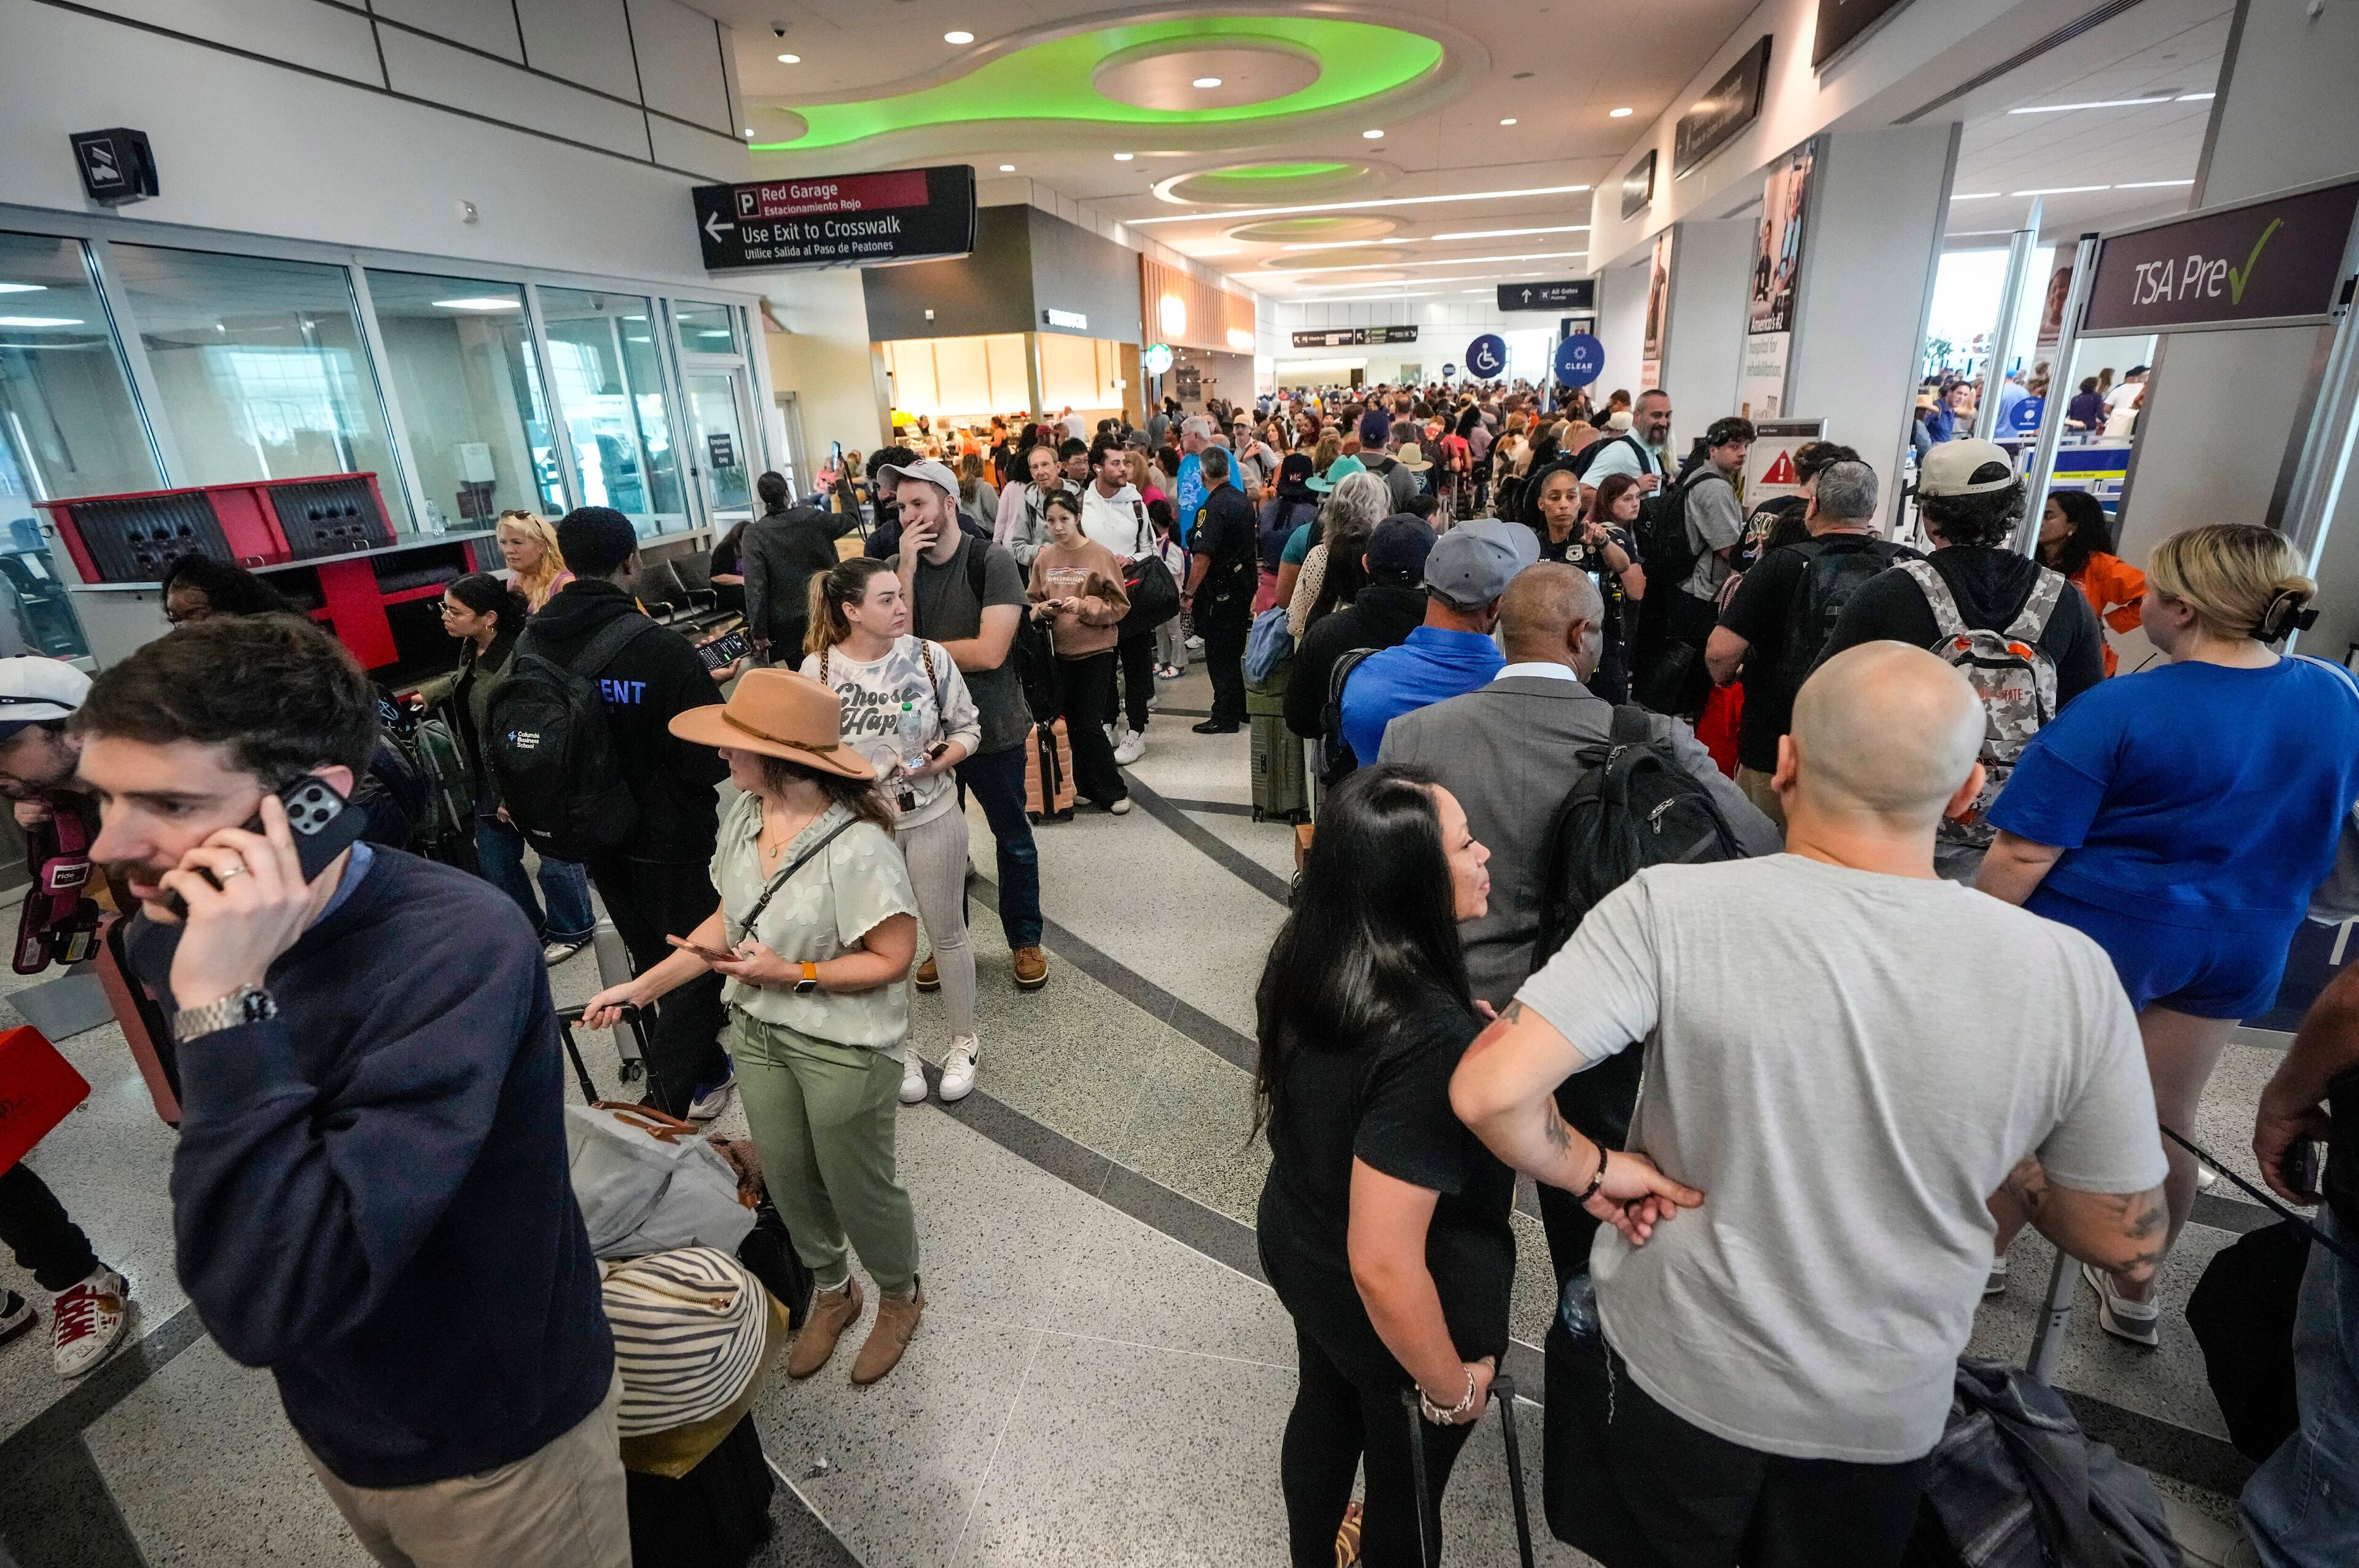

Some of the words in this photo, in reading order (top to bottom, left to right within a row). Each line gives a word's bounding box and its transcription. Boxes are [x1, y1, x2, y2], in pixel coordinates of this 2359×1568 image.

[762, 186, 786, 201] Red
[790, 183, 838, 198] Garage
[741, 193, 754, 213] P
[764, 202, 838, 216] Estacionamiento
[840, 199, 861, 211] Rojo
[742, 225, 769, 243] Use
[774, 224, 800, 241] Exit
[804, 222, 820, 238] to
[824, 216, 901, 238] Crosswalk
[745, 247, 772, 260] Utilice
[775, 244, 800, 257] Salida
[804, 245, 812, 255] al
[814, 244, 835, 254] Paso
[838, 242, 850, 252] de
[852, 240, 894, 253] Peatones
[2133, 259, 2174, 305] TSA
[2178, 254, 2228, 300] Pre
[1751, 313, 1775, 332] America's
[1775, 311, 1783, 330] #2
[835, 682, 922, 707] Choose
